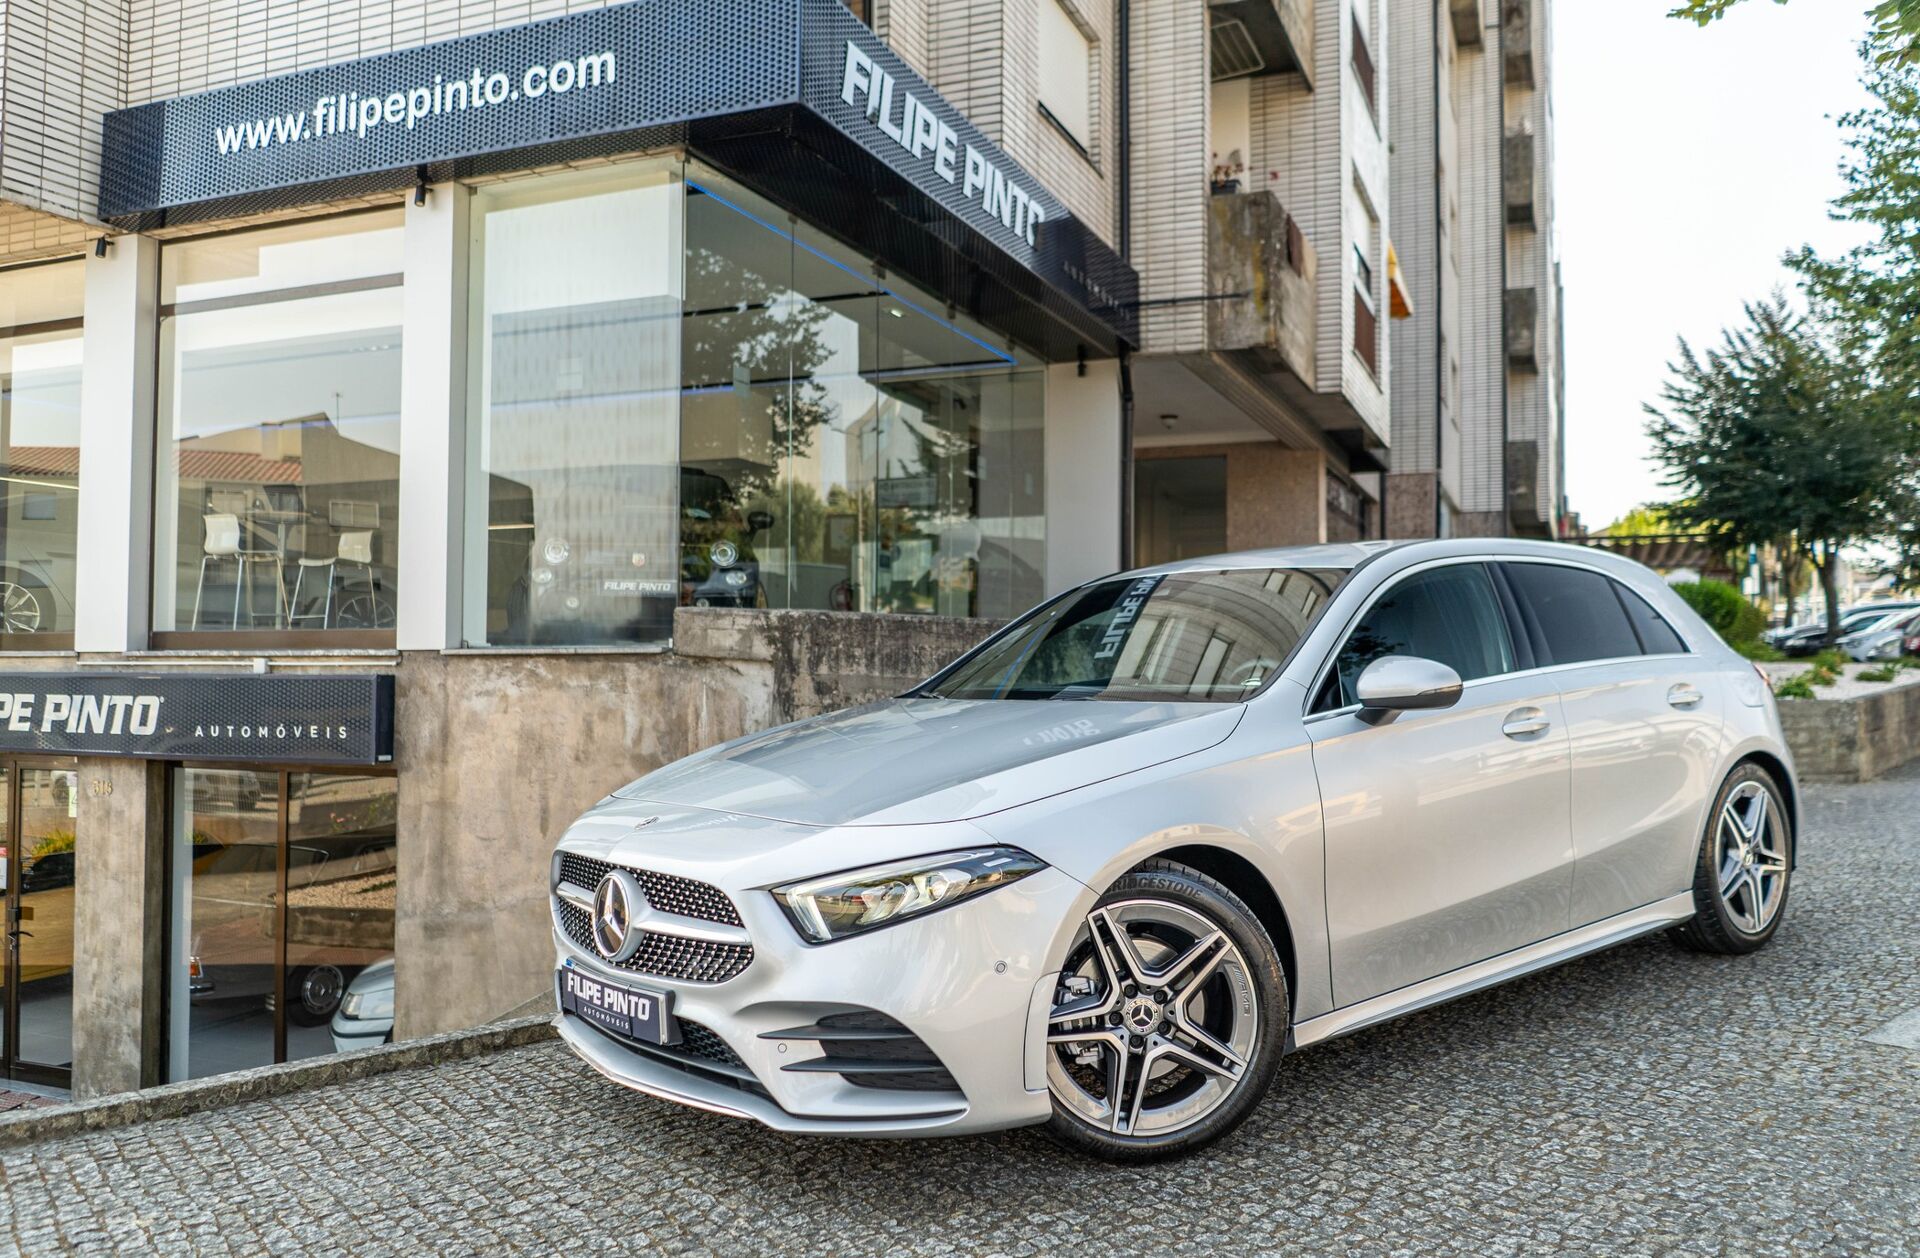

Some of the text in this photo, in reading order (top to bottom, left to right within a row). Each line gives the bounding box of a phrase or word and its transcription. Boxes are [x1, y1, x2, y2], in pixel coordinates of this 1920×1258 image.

[216, 51, 616, 155] www.filipepinto.com
[841, 40, 958, 184] FILIPE
[195, 723, 347, 740] AUTOMÓVEIS
[567, 971, 650, 1020] FILIPE PINTO
[583, 1005, 629, 1030] AUTOMÓVEIS
